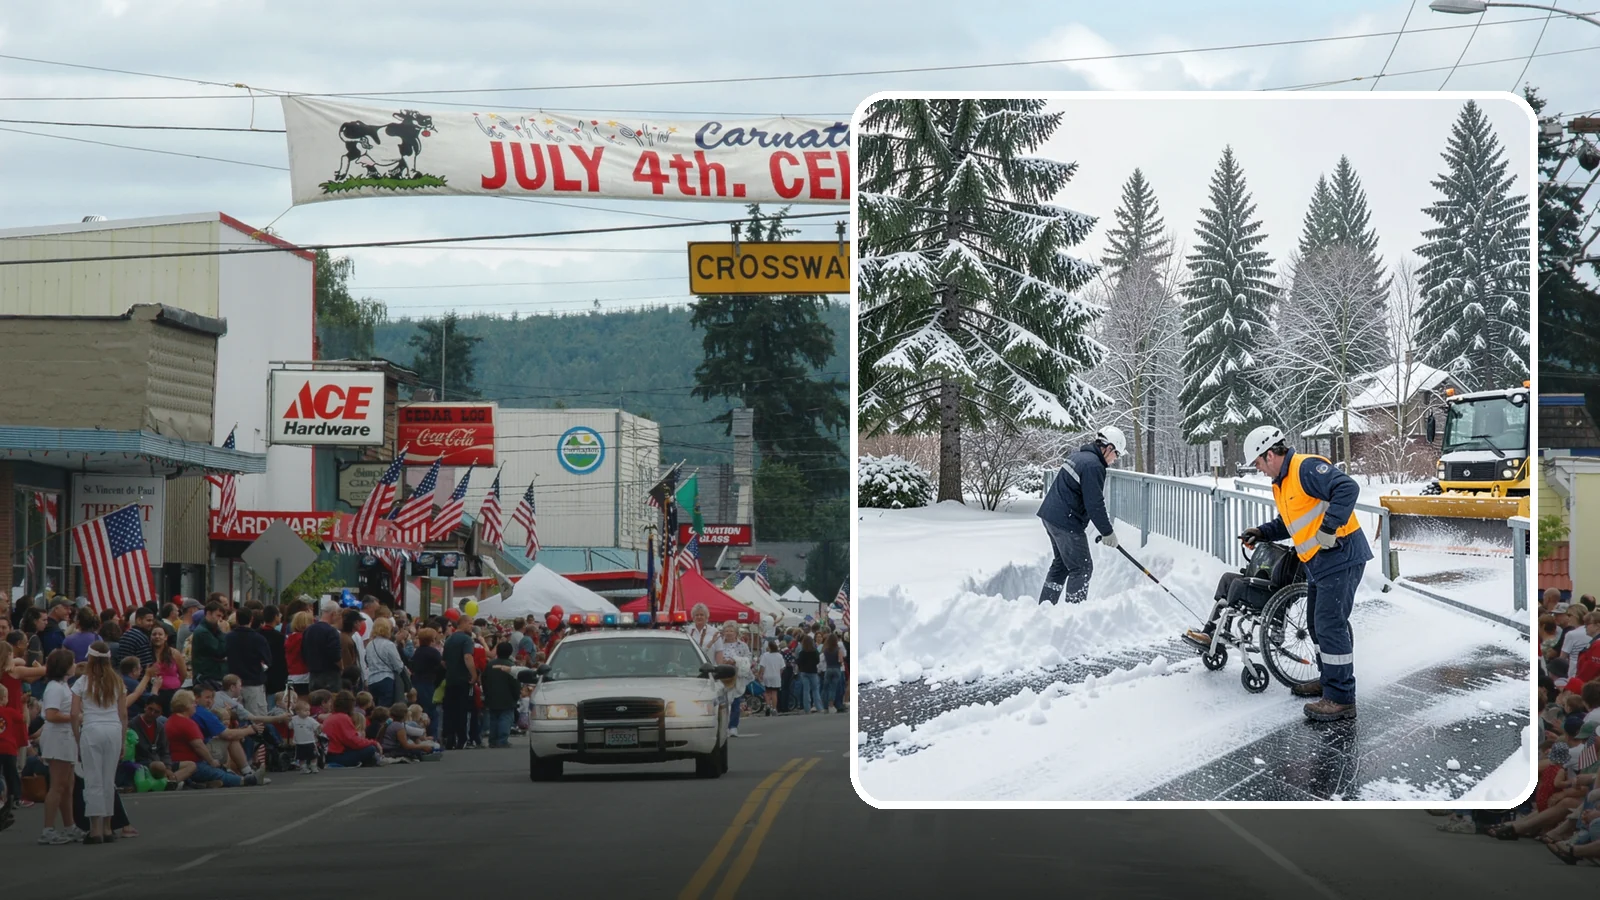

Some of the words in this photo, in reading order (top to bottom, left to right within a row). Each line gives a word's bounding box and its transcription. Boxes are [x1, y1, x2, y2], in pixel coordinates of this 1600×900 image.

[695, 121, 850, 150] Carnat
[481, 141, 605, 192] JULY
[632, 150, 747, 198] 4th.
[697, 254, 850, 280] CROSSWA
[283, 380, 373, 420] ACE
[405, 409, 453, 422] CEDAR
[284, 421, 370, 436] Hardware
[416, 428, 477, 447] Coca-Cola
[353, 467, 387, 480] Simpl
[95, 486, 124, 495] Vincent
[126, 486, 136, 495] de
[138, 486, 155, 496] Paul
[81, 503, 154, 522] THT
[212, 516, 330, 535] HARDARE
[688, 526, 741, 535] CRNATION
[699, 535, 730, 543] GLASS
